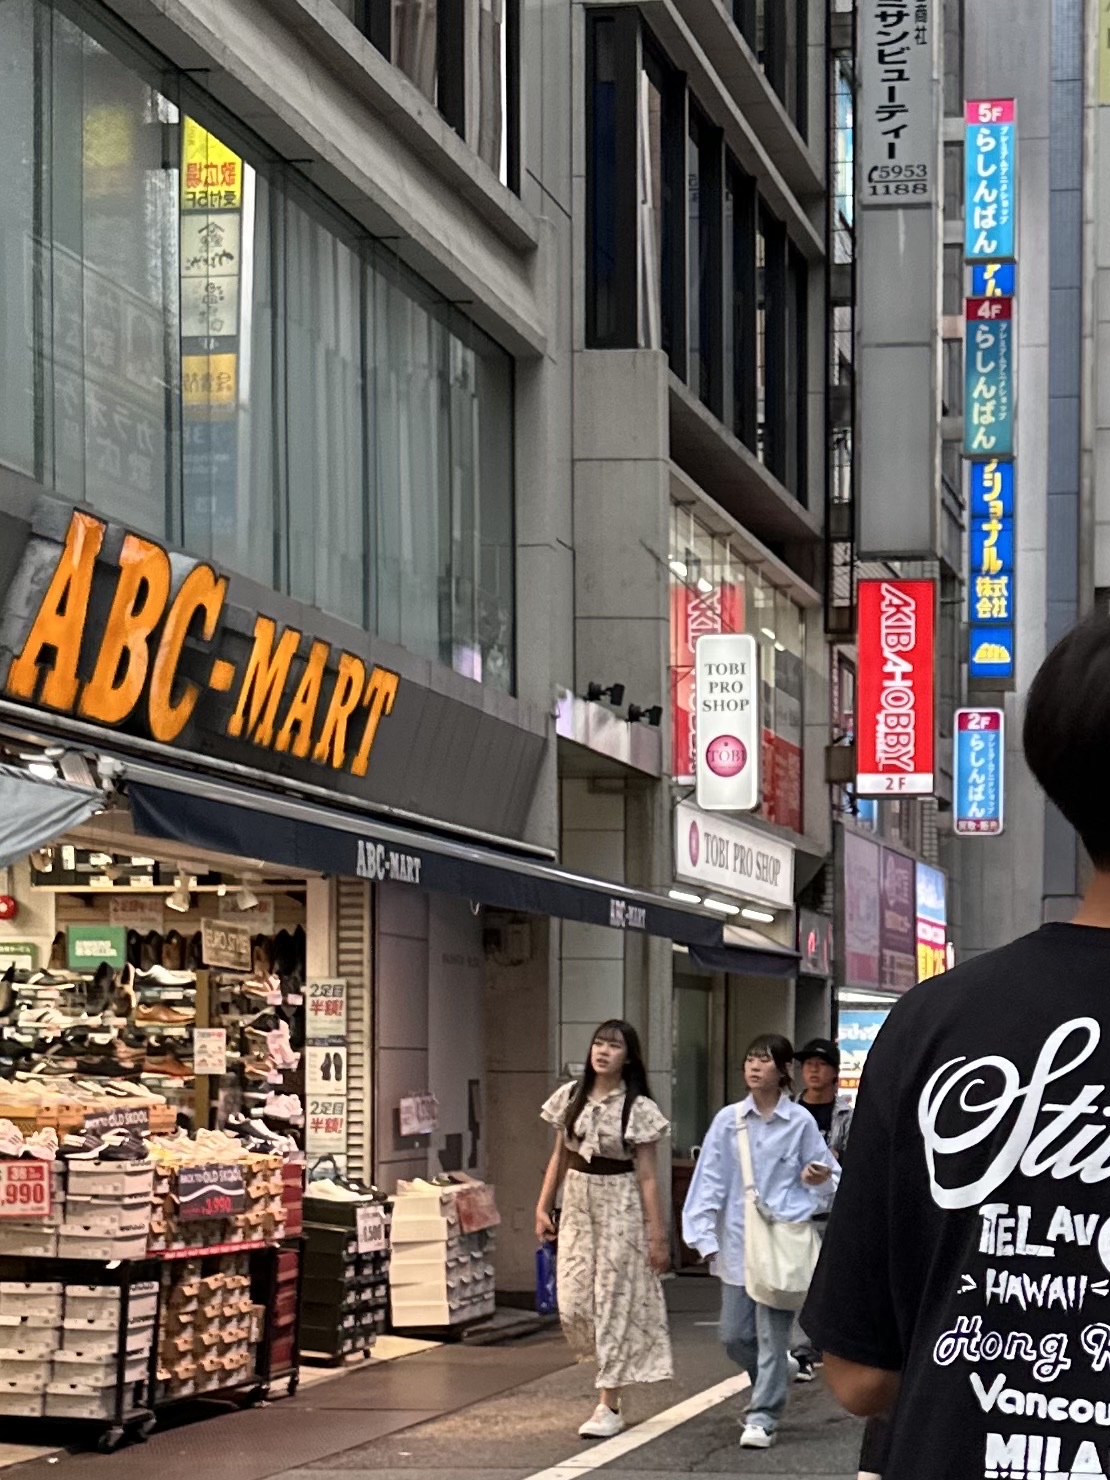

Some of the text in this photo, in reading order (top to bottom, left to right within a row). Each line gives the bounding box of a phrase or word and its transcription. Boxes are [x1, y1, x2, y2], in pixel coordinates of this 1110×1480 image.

[978, 102, 1003, 123] 5F
[869, 183, 928, 196] 1188
[878, 164, 928, 179] 5953
[972, 126, 999, 254] らしんばん
[977, 300, 1003, 319] 4F
[971, 323, 998, 450] らしんばん
[981, 458, 1004, 576] ショナル
[8, 507, 400, 778] ABC-MART
[704, 662, 747, 676] TOBI
[708, 680, 744, 694] PRO
[702, 698, 750, 712] SHOP
[967, 712, 992, 730] 2F
[968, 733, 986, 818] らしんばん
[356, 839, 421, 885] ABC-MART
[704, 831, 782, 888] TOBI PRO SHOP
[978, 1203, 1055, 1257] TEL
[985, 1267, 1088, 1311] HAWAII
[933, 1315, 1071, 1382] Hong
